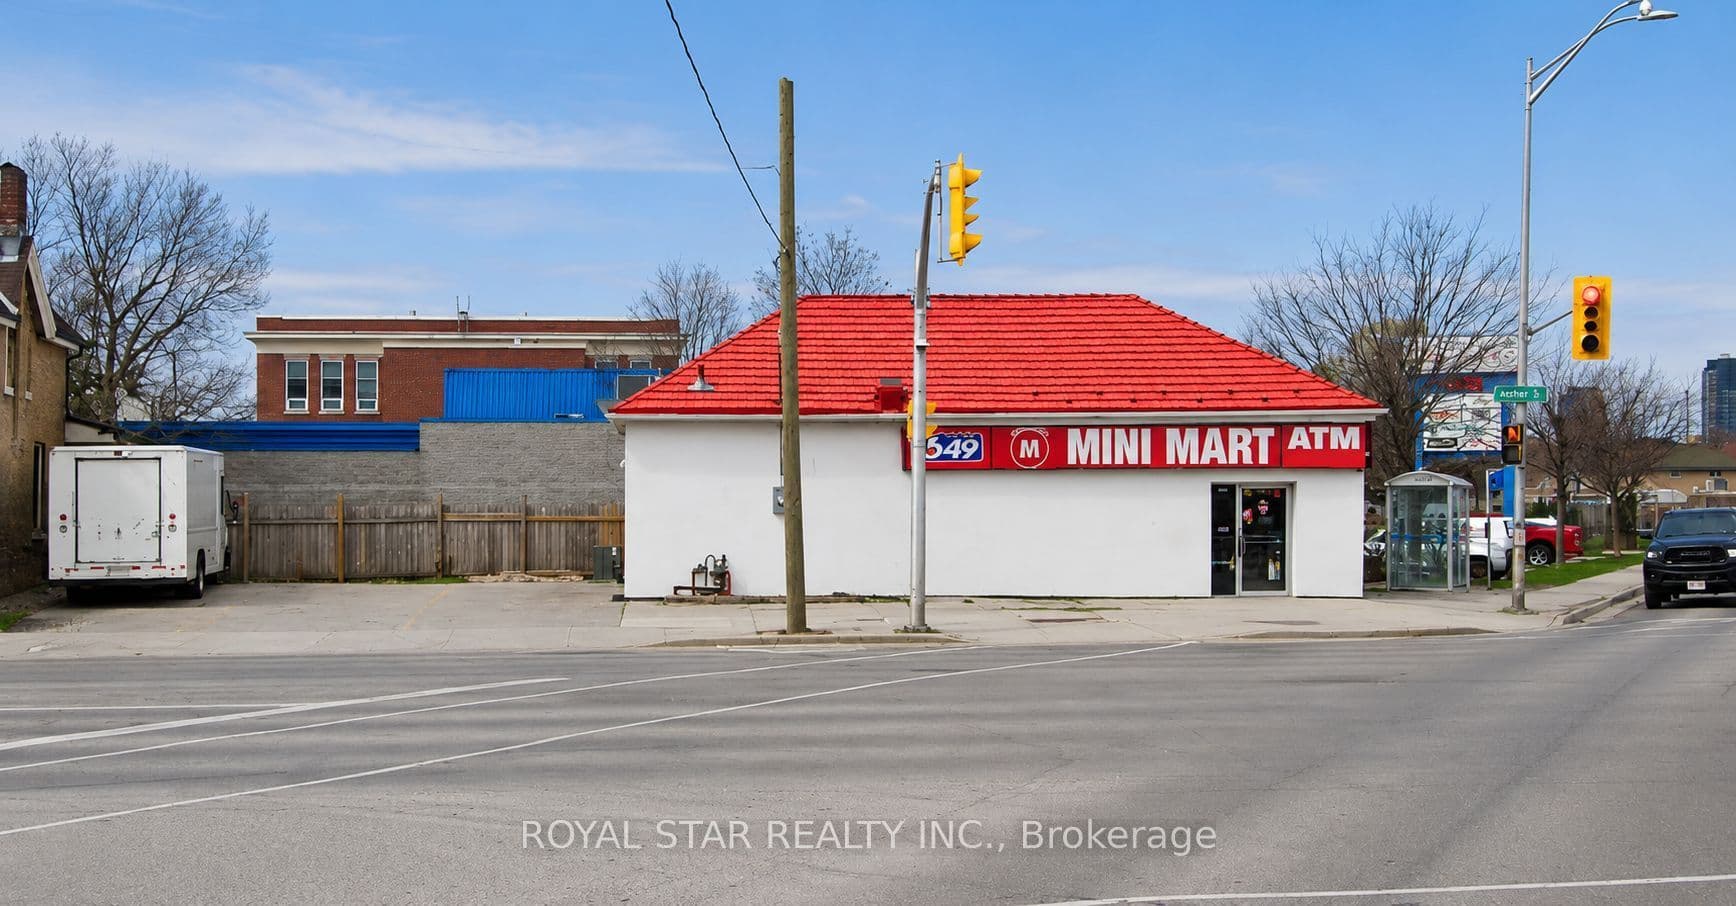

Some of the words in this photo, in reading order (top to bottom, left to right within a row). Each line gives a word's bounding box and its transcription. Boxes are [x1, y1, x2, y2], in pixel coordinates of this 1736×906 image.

[925, 436, 979, 460] 649
[1019, 439, 1040, 459] M
[1067, 428, 1151, 465] MINI
[1166, 428, 1275, 464] MART
[1287, 426, 1360, 450] ATM
